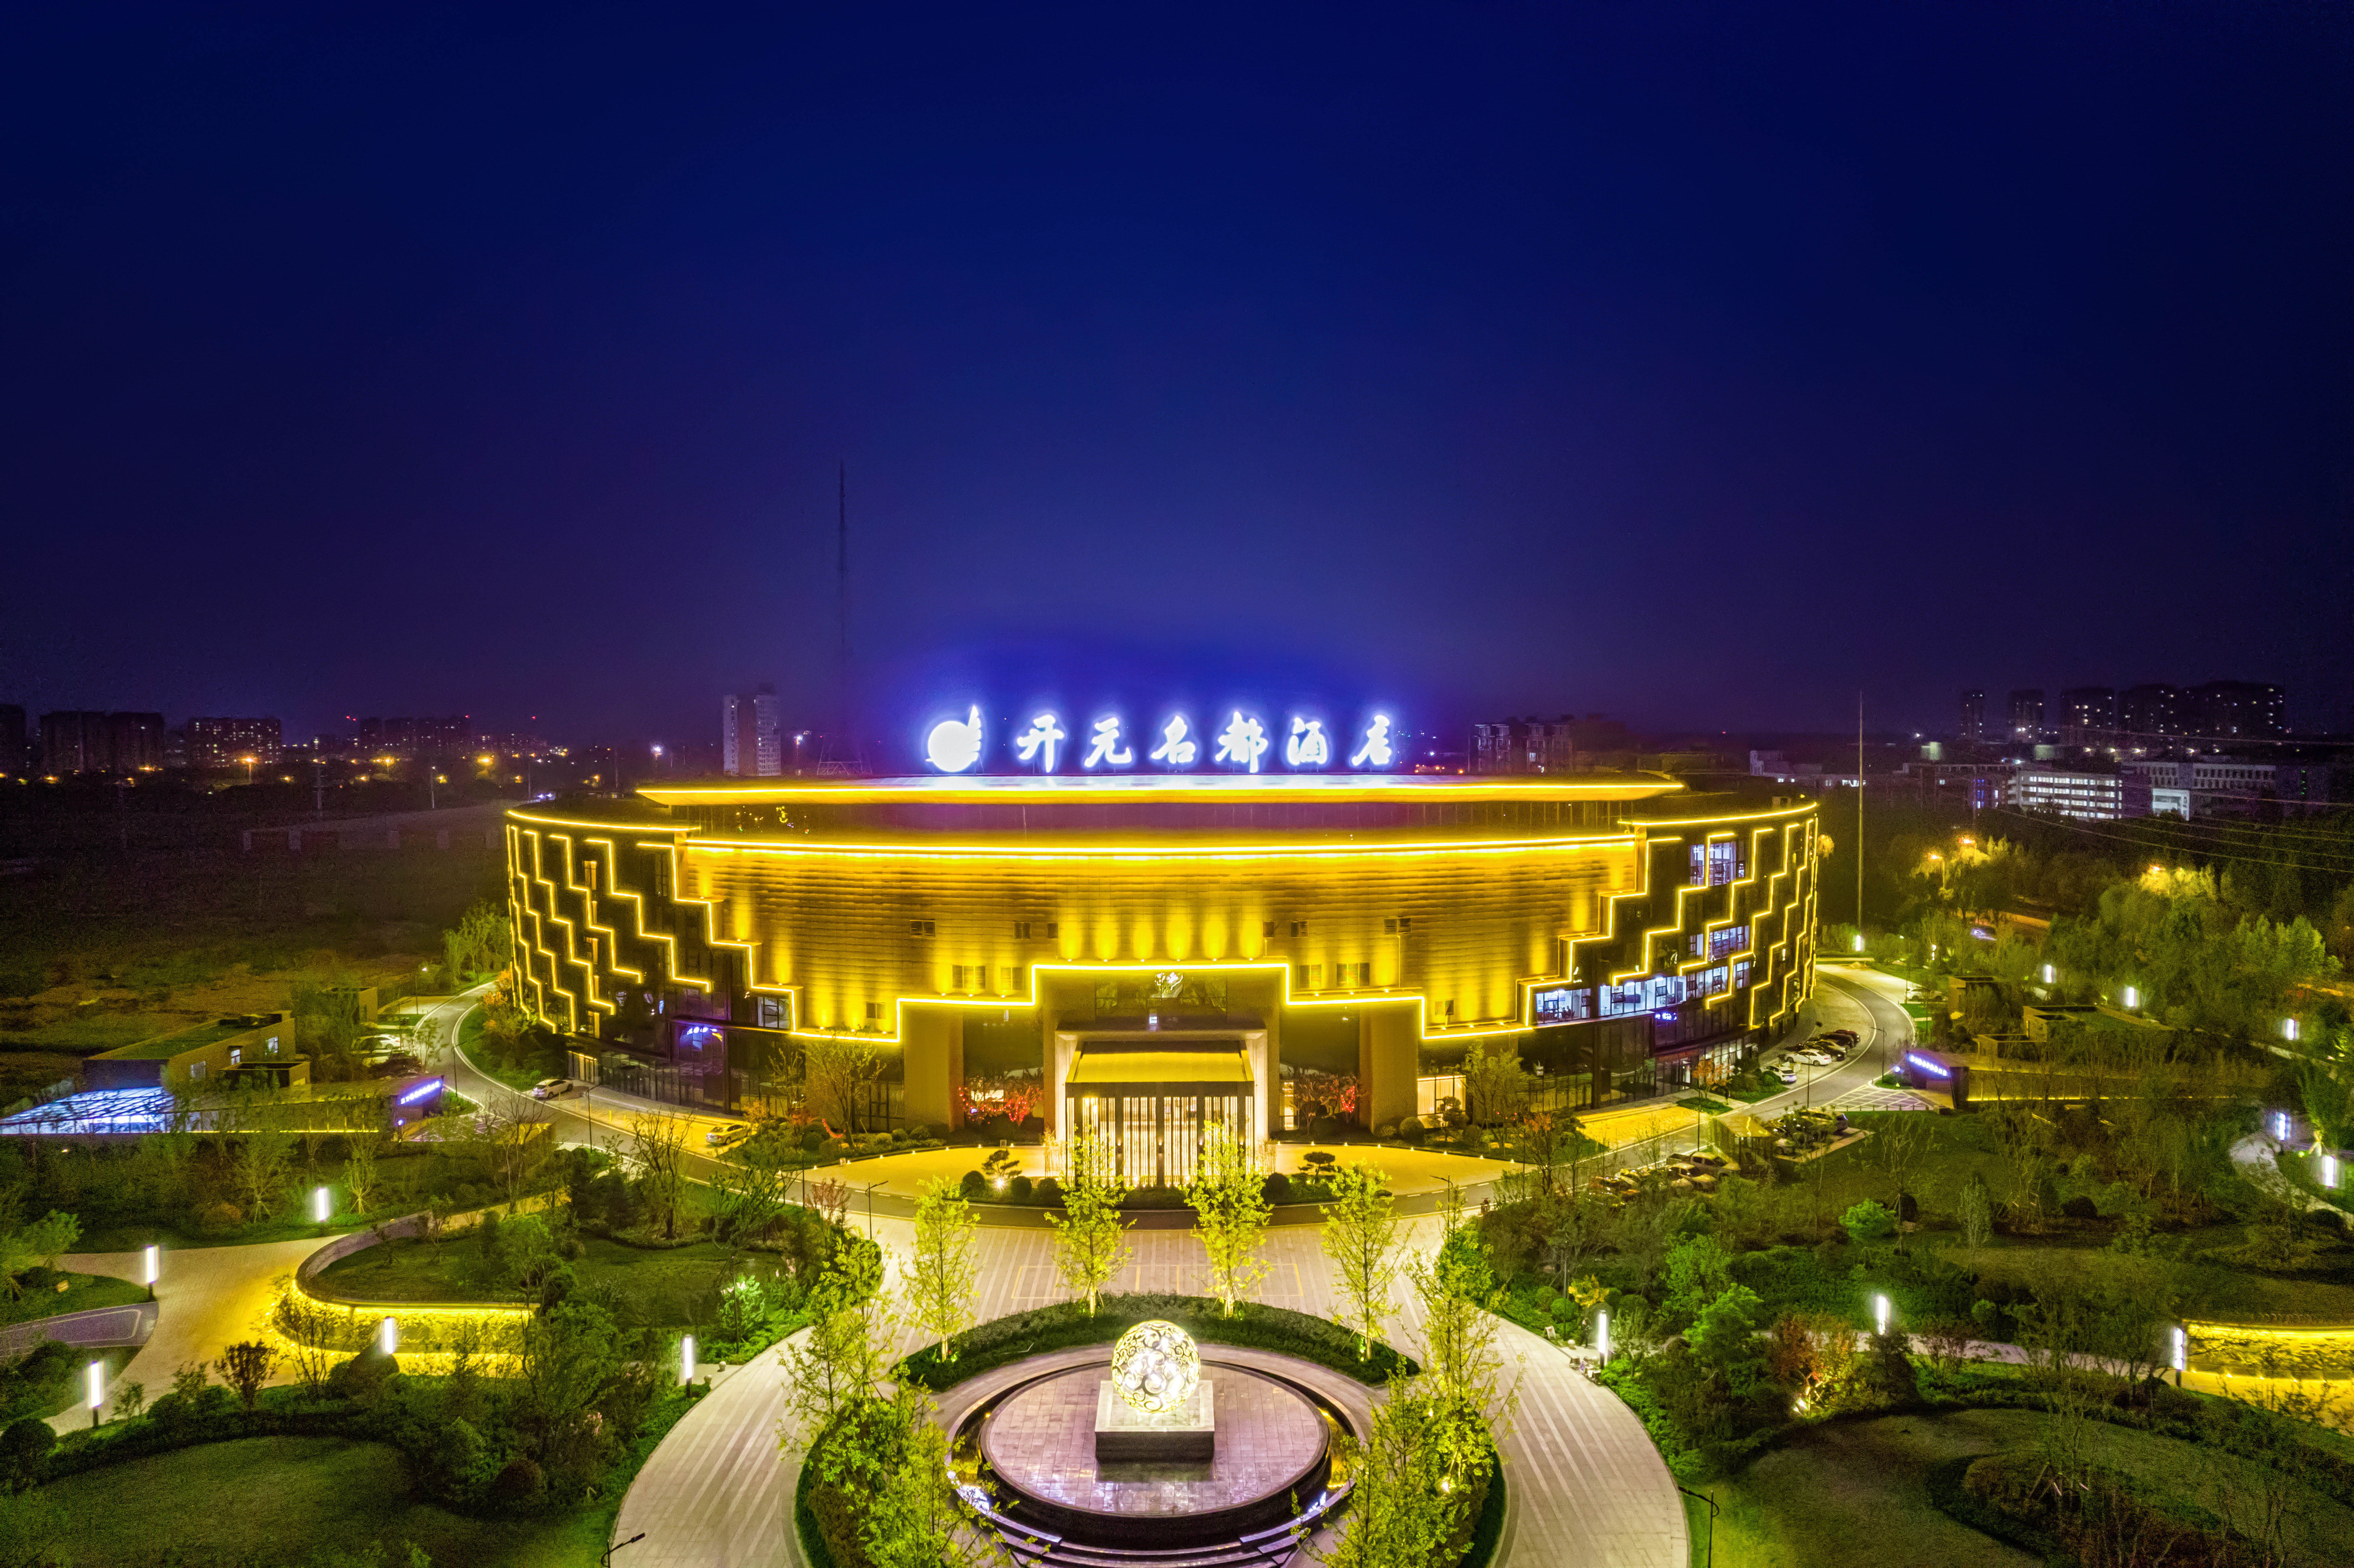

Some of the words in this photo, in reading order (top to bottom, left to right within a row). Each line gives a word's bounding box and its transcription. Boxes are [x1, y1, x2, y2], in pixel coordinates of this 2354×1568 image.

[1016, 710, 1393, 773] 开元名都酒店
